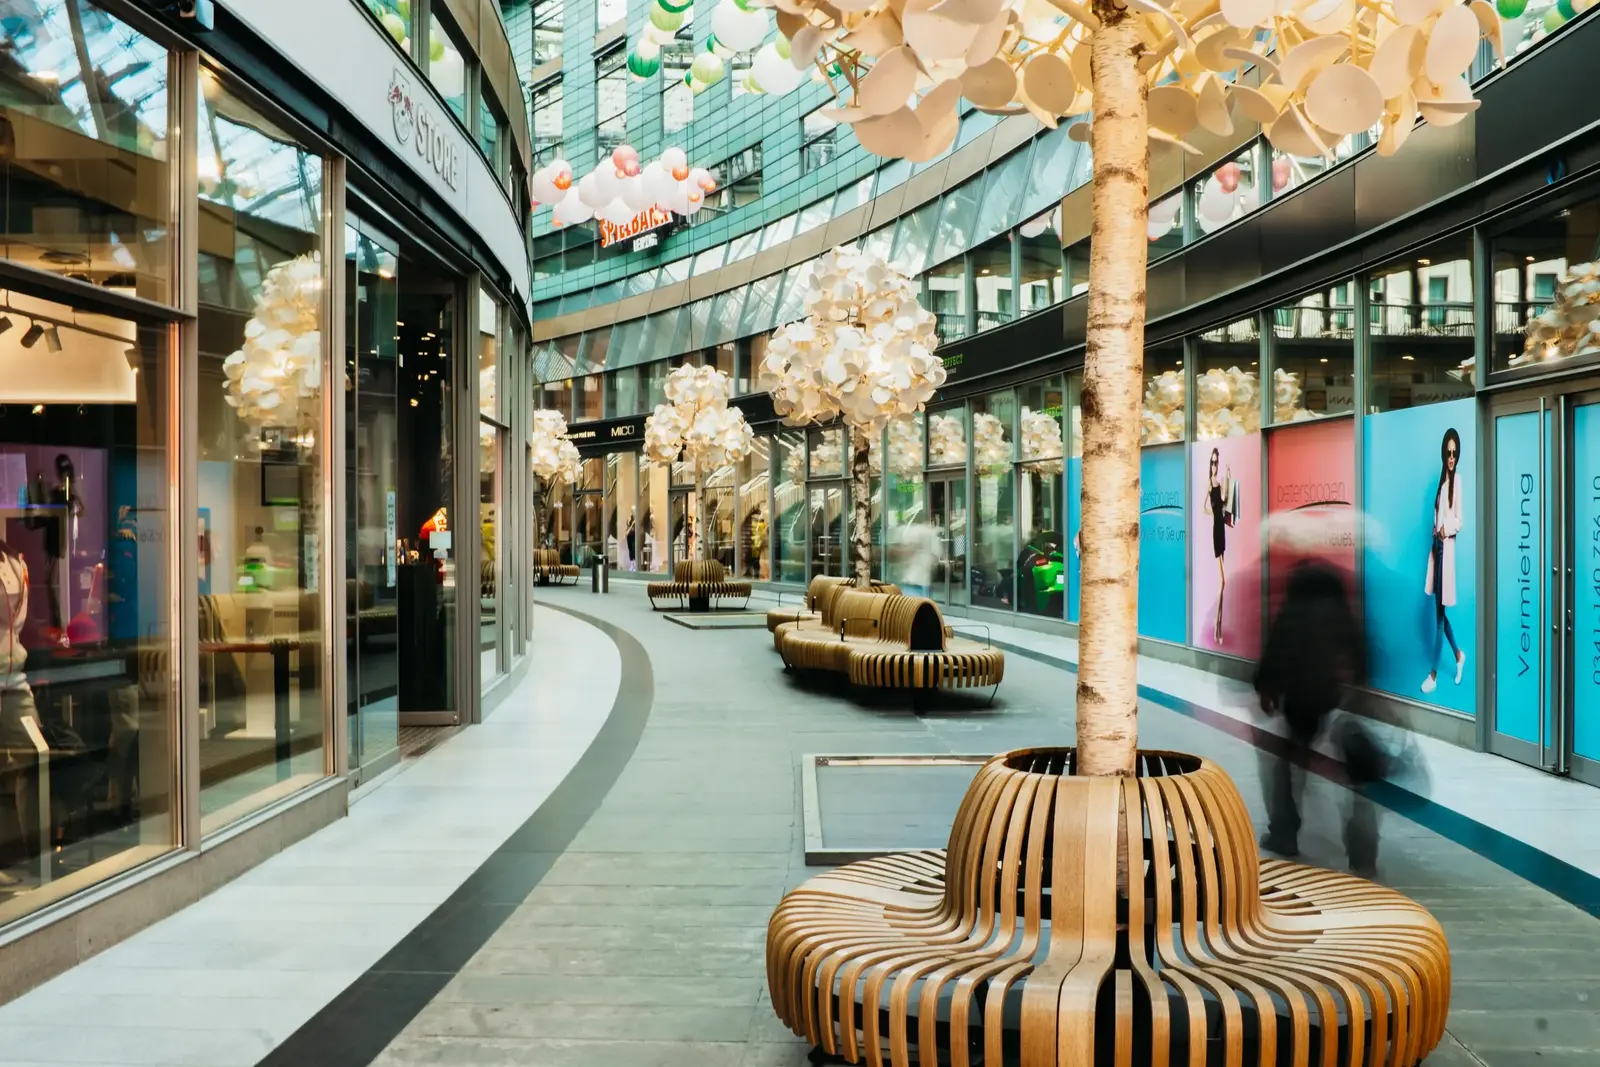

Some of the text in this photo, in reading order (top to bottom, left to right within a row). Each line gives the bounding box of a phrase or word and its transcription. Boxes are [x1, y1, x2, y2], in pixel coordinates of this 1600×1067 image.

[416, 103, 458, 193] STORE
[611, 425, 635, 437] MICO
[1517, 473, 1533, 678] Vermietung
